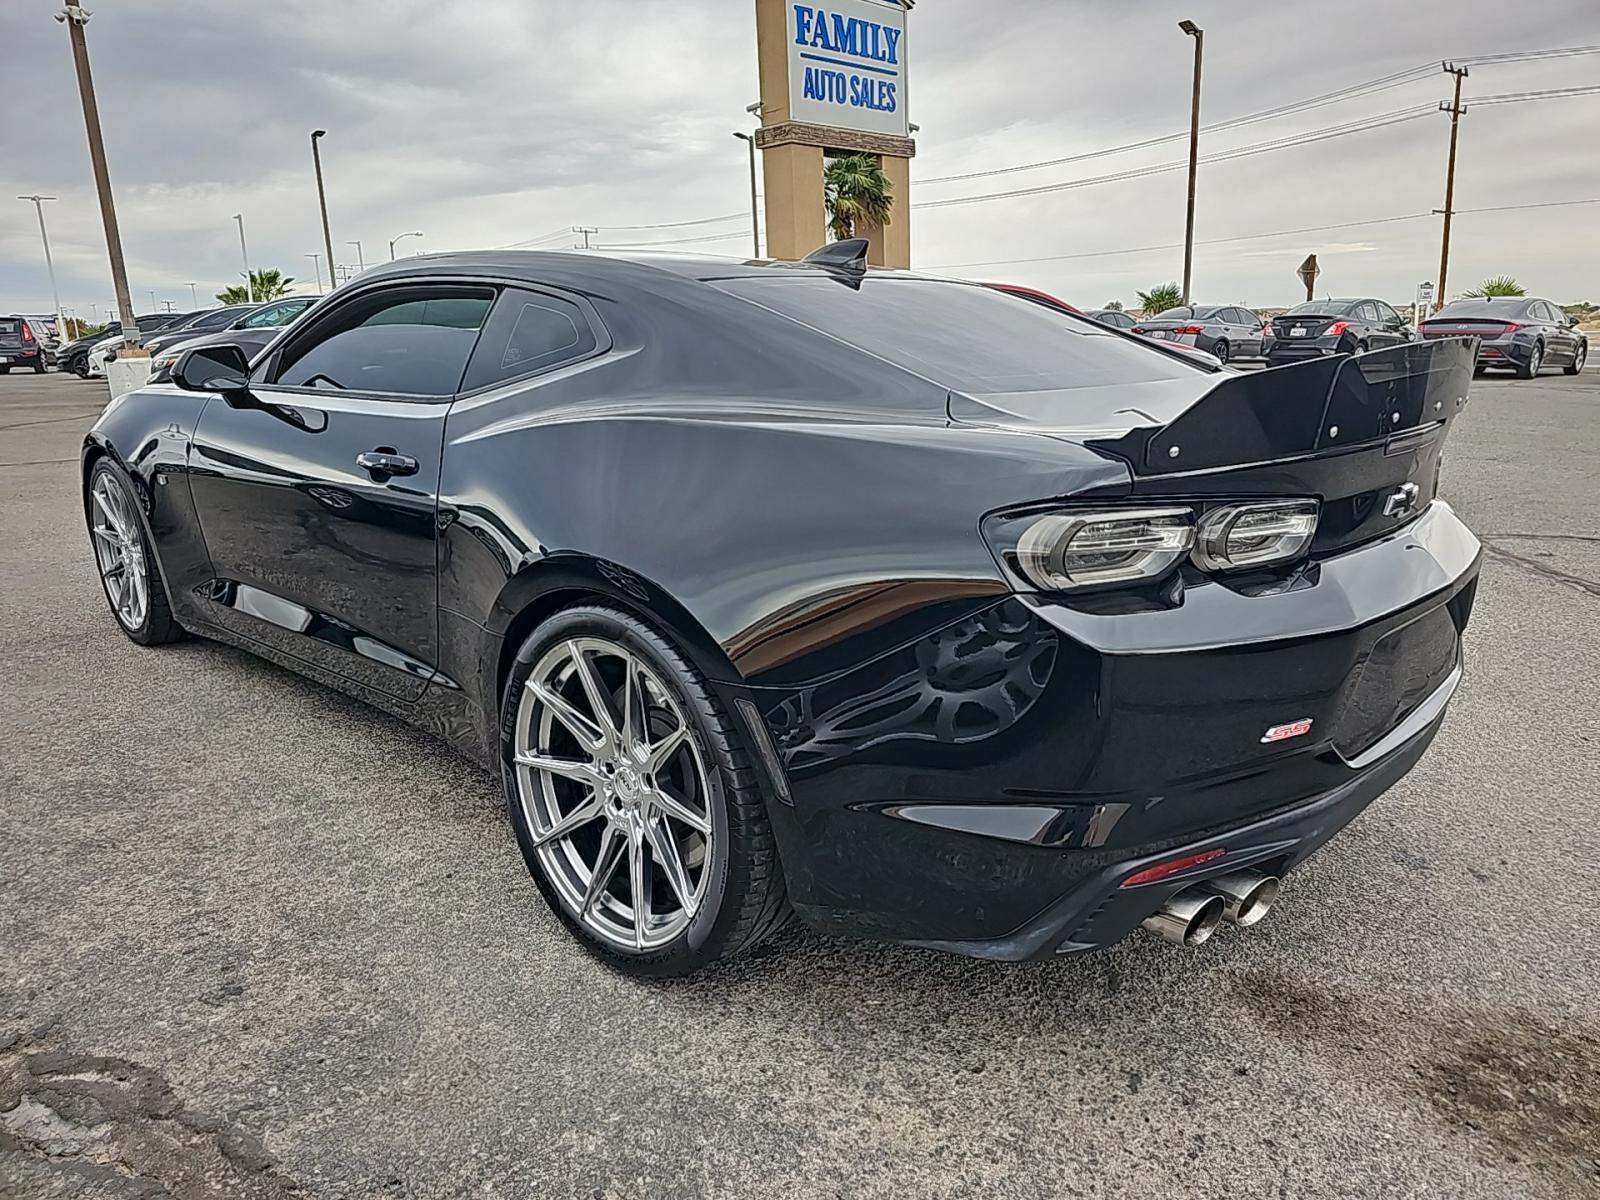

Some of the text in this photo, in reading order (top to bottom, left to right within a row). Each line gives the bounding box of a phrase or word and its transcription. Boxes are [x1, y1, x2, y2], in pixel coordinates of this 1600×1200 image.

[794, 5, 901, 65] FAMILY
[804, 67, 897, 113] AUTO SALES
[1262, 719, 1312, 742] SS
